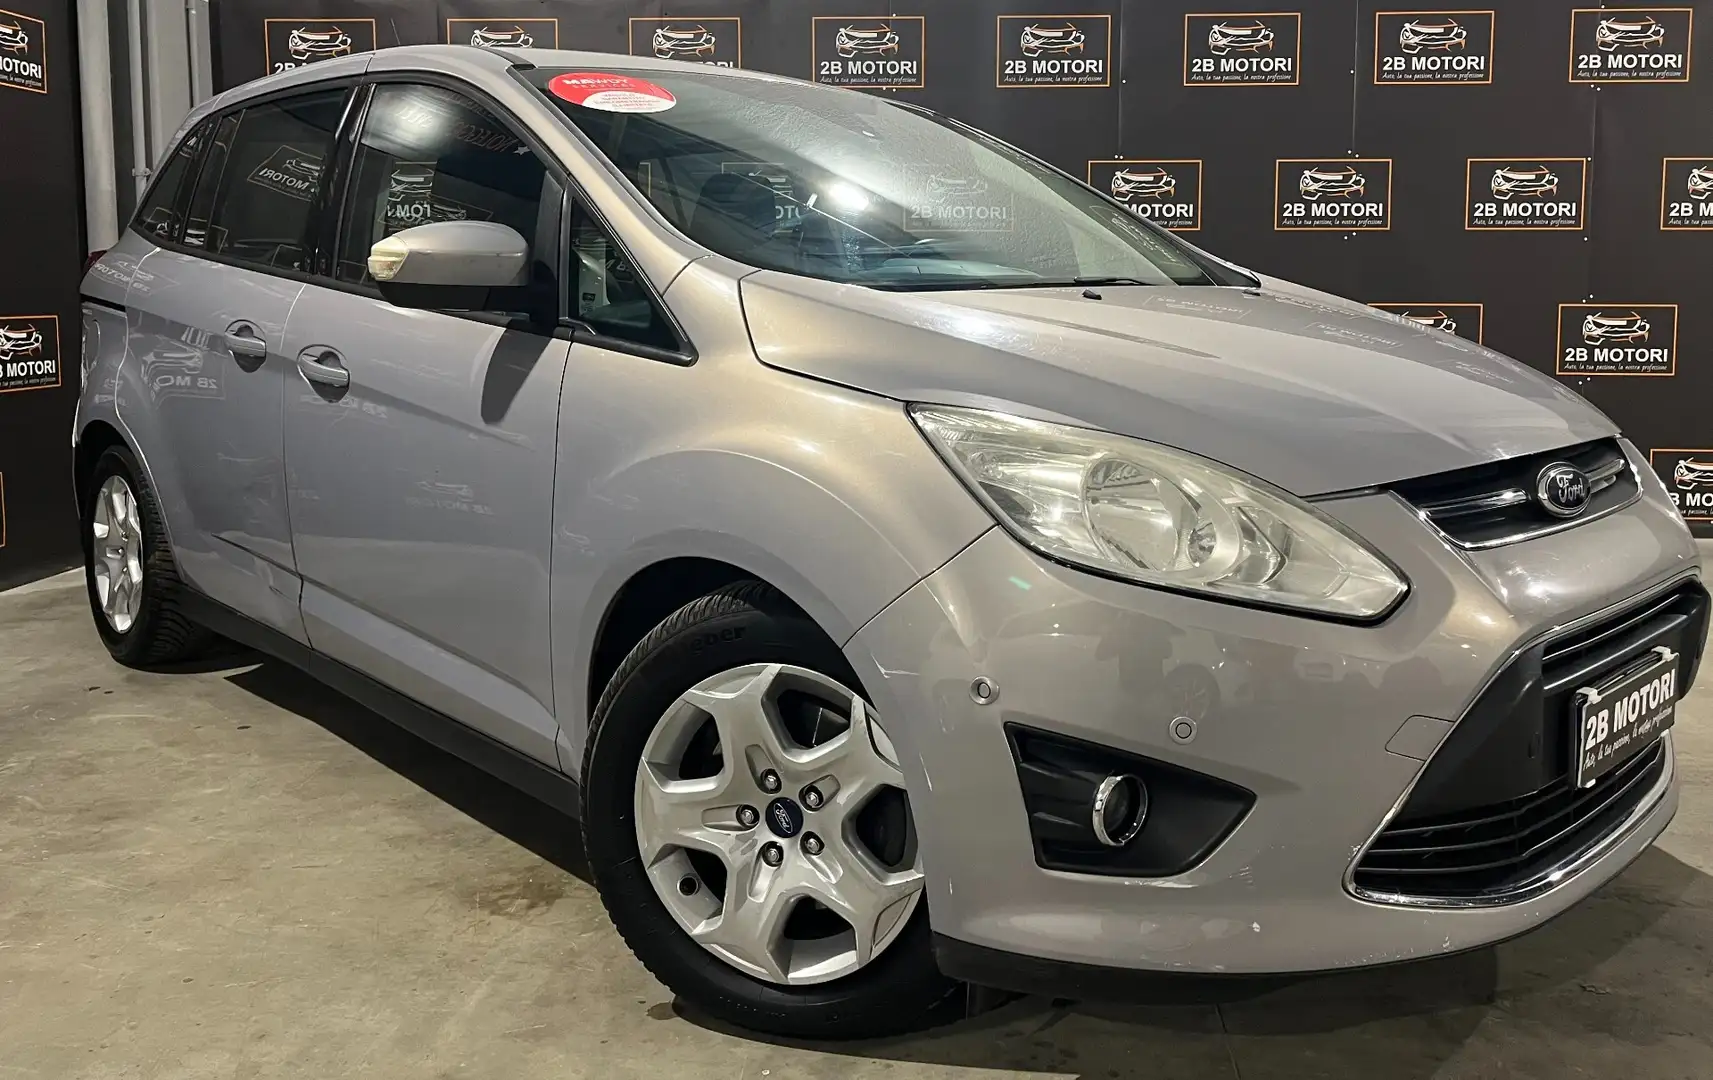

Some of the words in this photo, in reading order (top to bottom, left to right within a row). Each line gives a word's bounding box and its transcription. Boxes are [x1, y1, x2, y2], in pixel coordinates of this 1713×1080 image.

[0, 56, 41, 78] OTORI
[820, 61, 842, 74] 2B
[848, 61, 916, 74] MOTORI
[1004, 61, 1026, 73] 2B
[1033, 60, 1102, 73] MOTORI
[1192, 59, 1214, 72] 2B
[1220, 58, 1291, 71] MOTORI
[1383, 57, 1405, 70] 2B
[1412, 56, 1484, 70] MOTORI
[1578, 55, 1601, 68] 2B
[1608, 54, 1682, 68] MOTORI
[938, 205, 1007, 219] MOTORI
[1283, 203, 1305, 216] 2B
[1311, 203, 1383, 216] MOTORI
[1474, 203, 1497, 216] 2B
[1503, 203, 1576, 216] MOTORI
[1669, 202, 1693, 217] 2B
[1565, 348, 1587, 361] 2B
[1594, 348, 1668, 362] MOTORI
[7, 360, 56, 377] MOTORI
[1556, 473, 1585, 503] Ford
[1585, 709, 1609, 750] 2B
[1613, 668, 1675, 733] MOTORI
[775, 808, 790, 828] Ford
